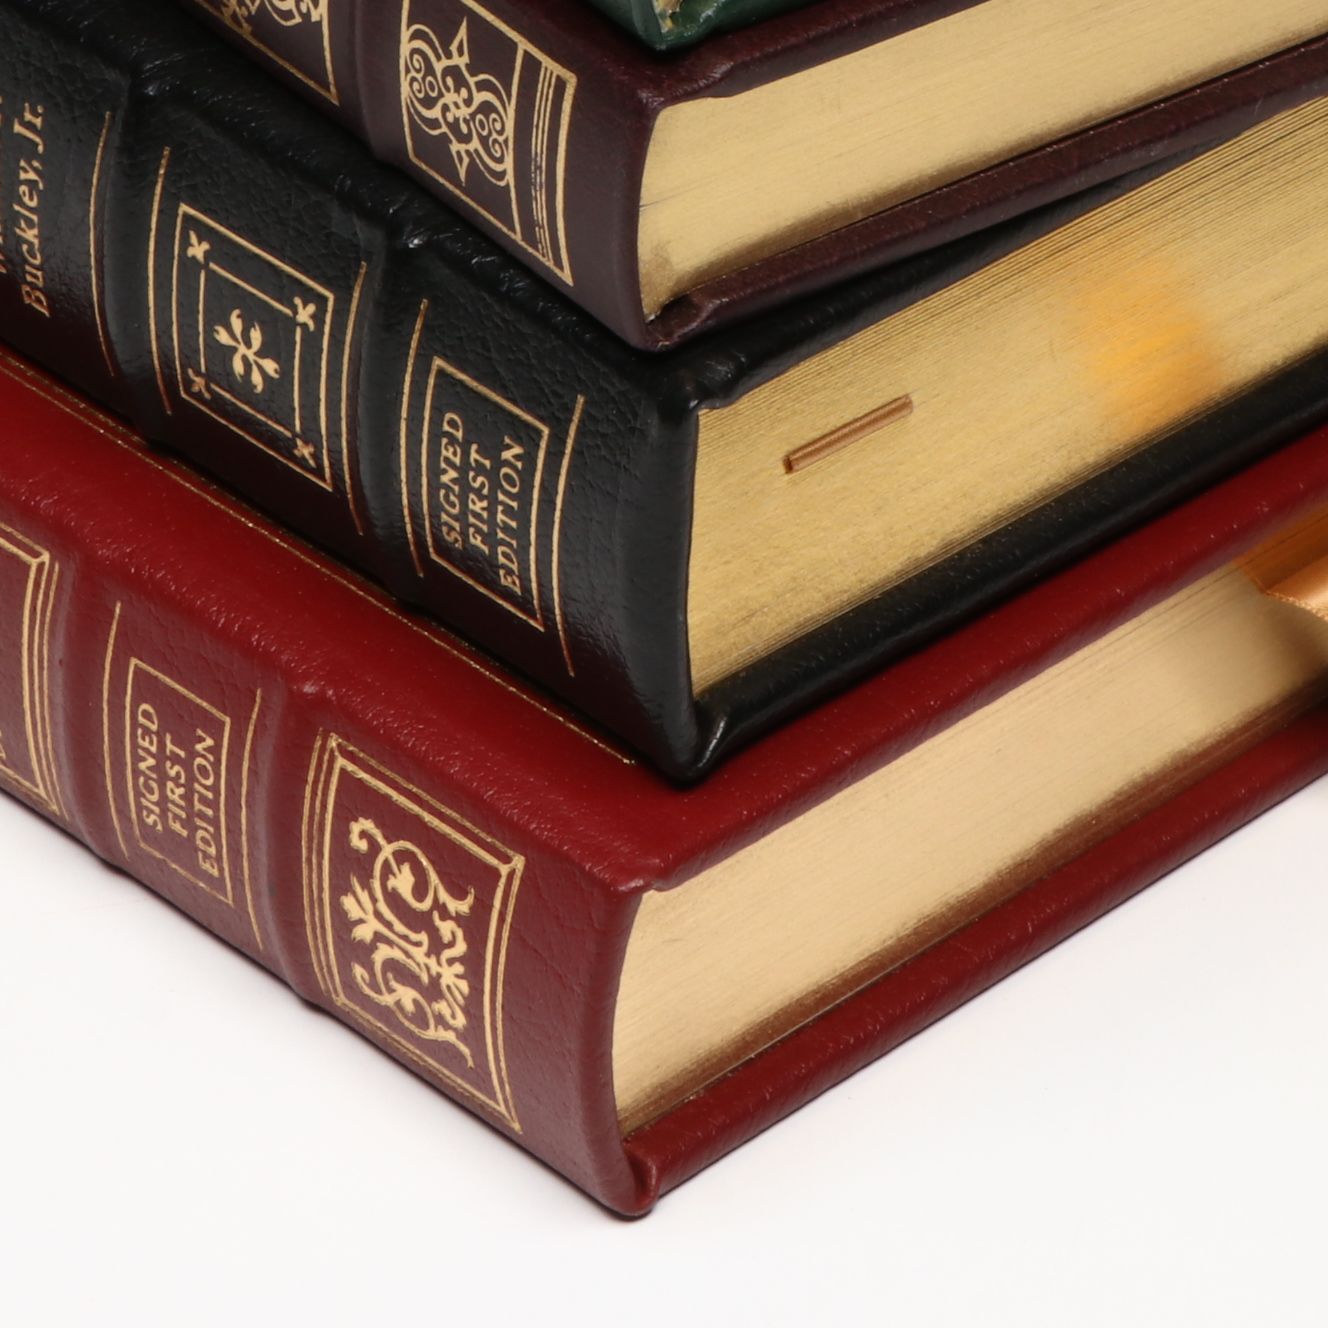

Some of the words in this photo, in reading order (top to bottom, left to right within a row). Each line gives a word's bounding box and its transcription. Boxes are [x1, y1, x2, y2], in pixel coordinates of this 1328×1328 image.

[13, 102, 45, 154] Jr.
[12, 159, 51, 318] Buckley,
[439, 412, 464, 550] SIGNED
[468, 442, 492, 555] FIRST
[496, 435, 525, 596] EDITION
[137, 702, 163, 833] SIGNED
[164, 732, 189, 838] FIRST
[192, 728, 220, 878] EDITION
